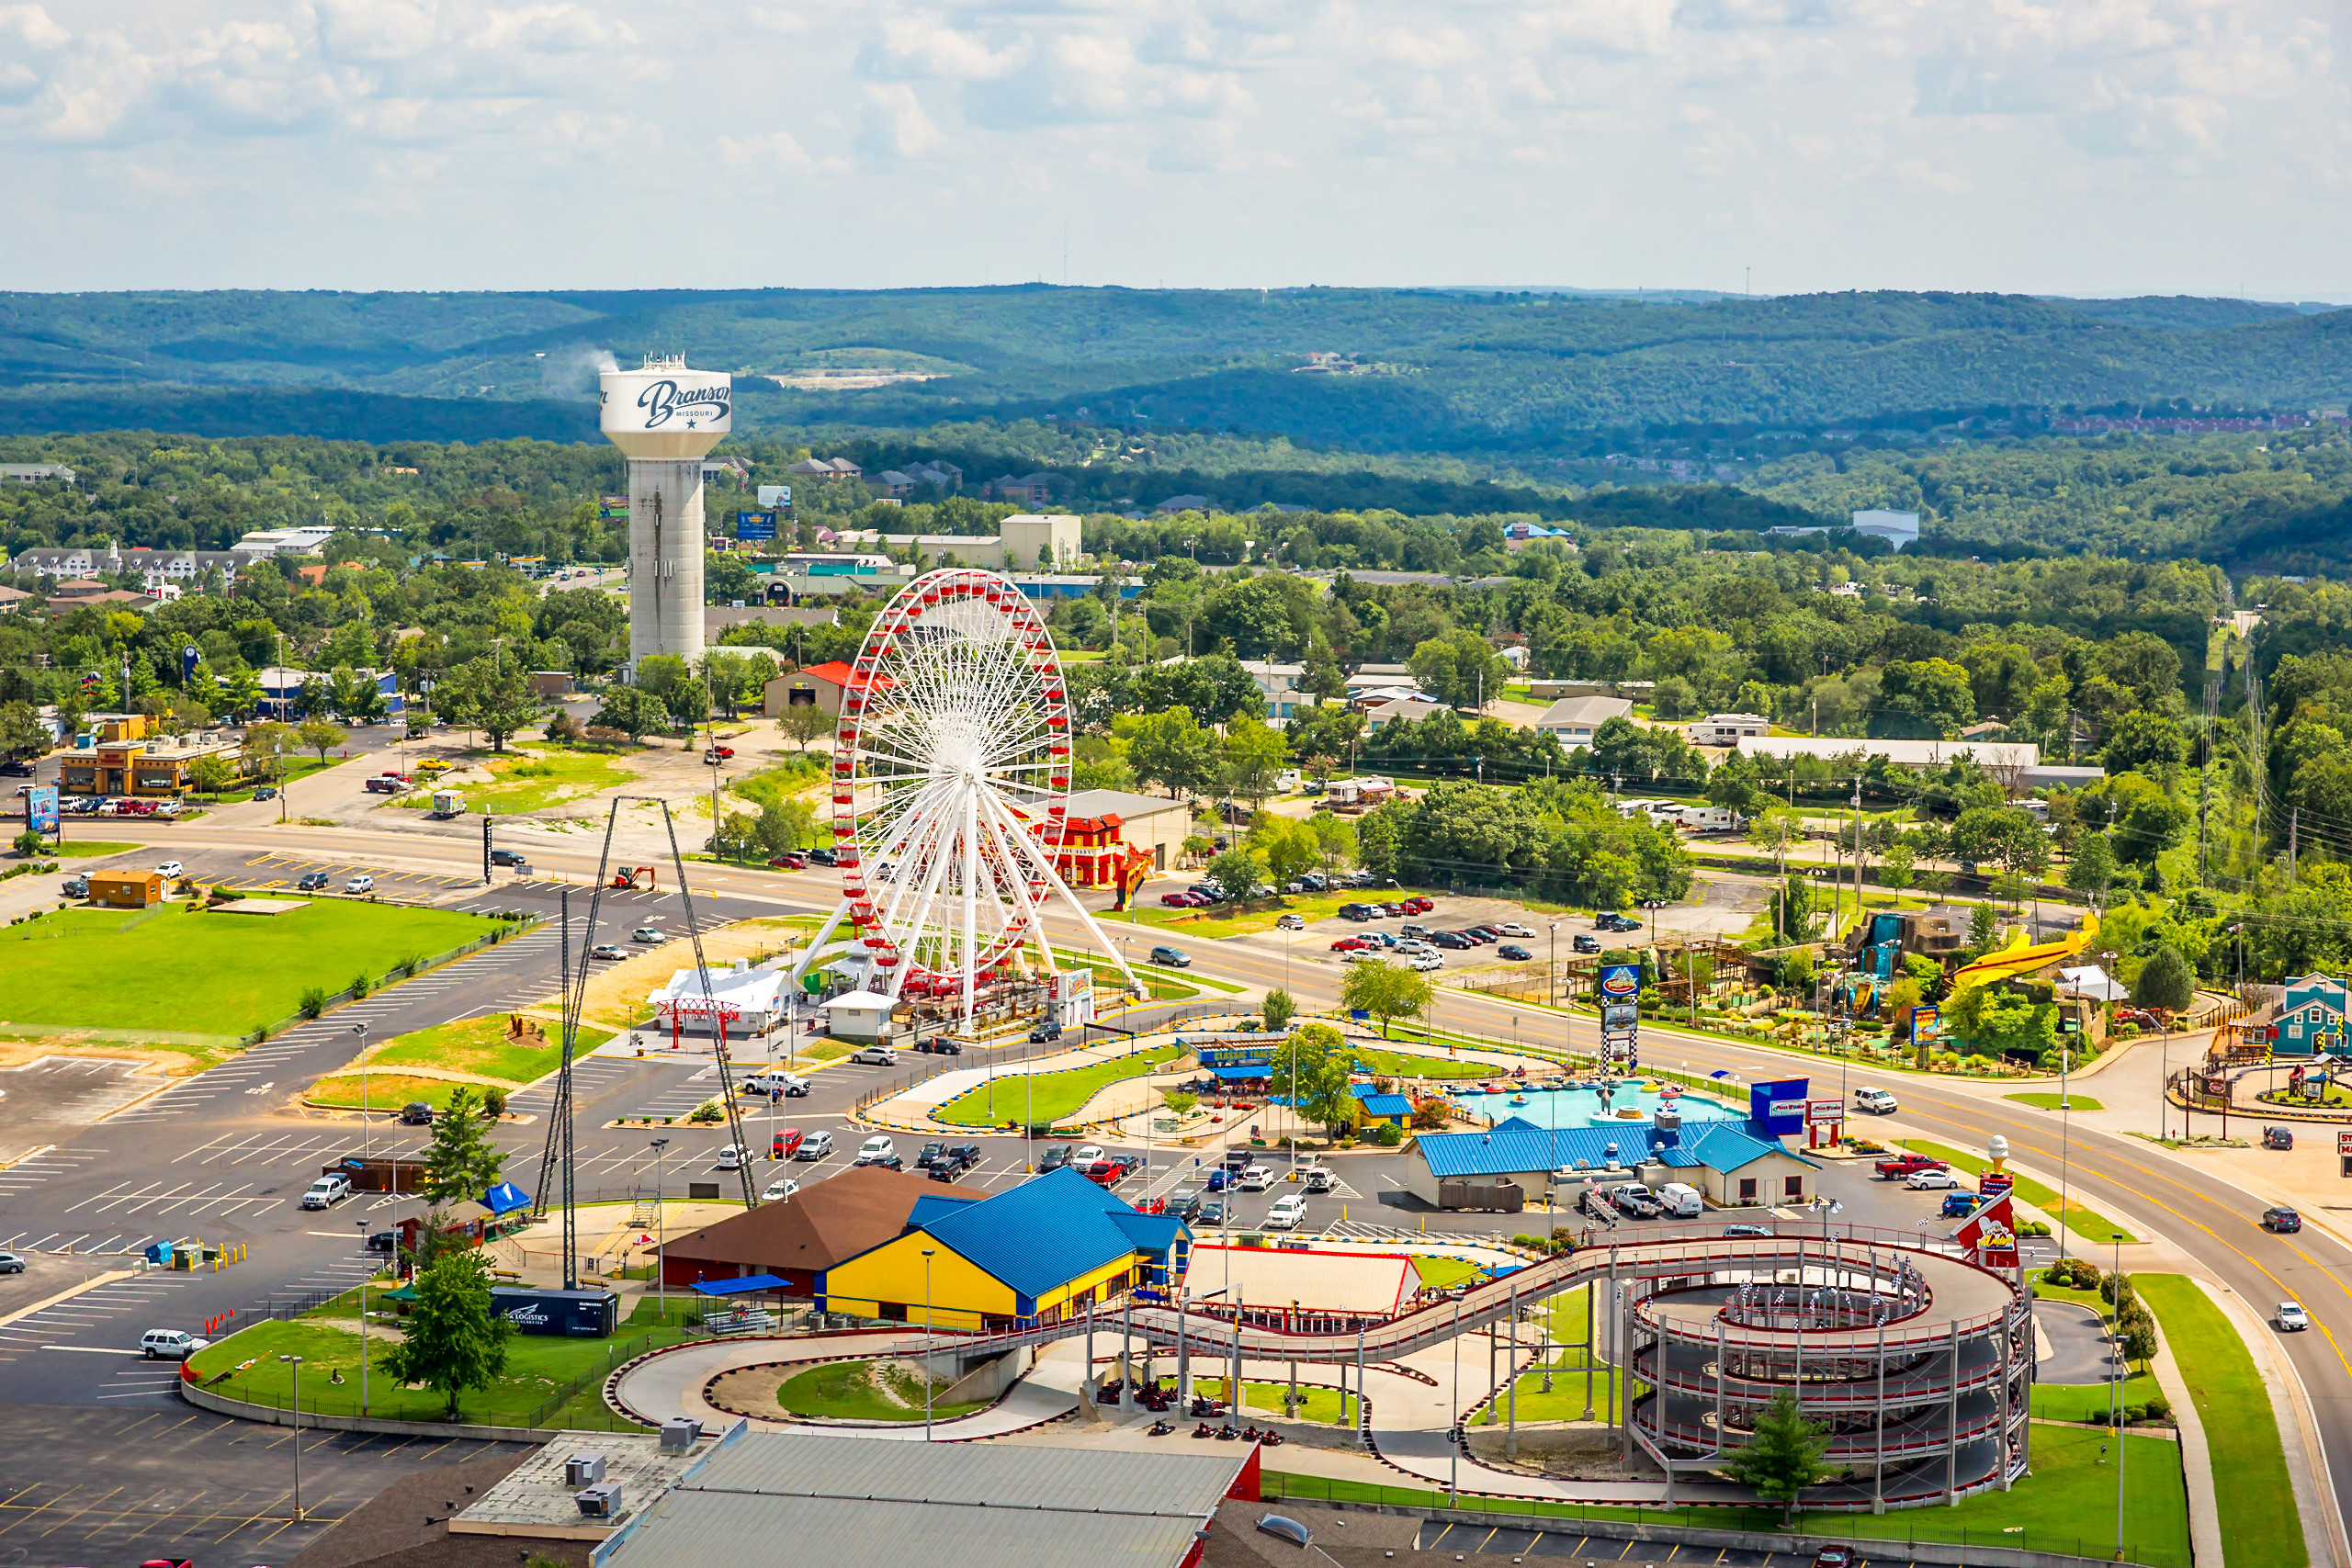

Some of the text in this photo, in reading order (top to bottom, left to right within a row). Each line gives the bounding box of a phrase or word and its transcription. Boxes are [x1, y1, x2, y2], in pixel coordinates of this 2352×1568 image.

[638, 380, 731, 429] Branson
[1214, 1050, 1247, 1061] CLASSIC
[515, 1314, 548, 1322] LOGISTICS
